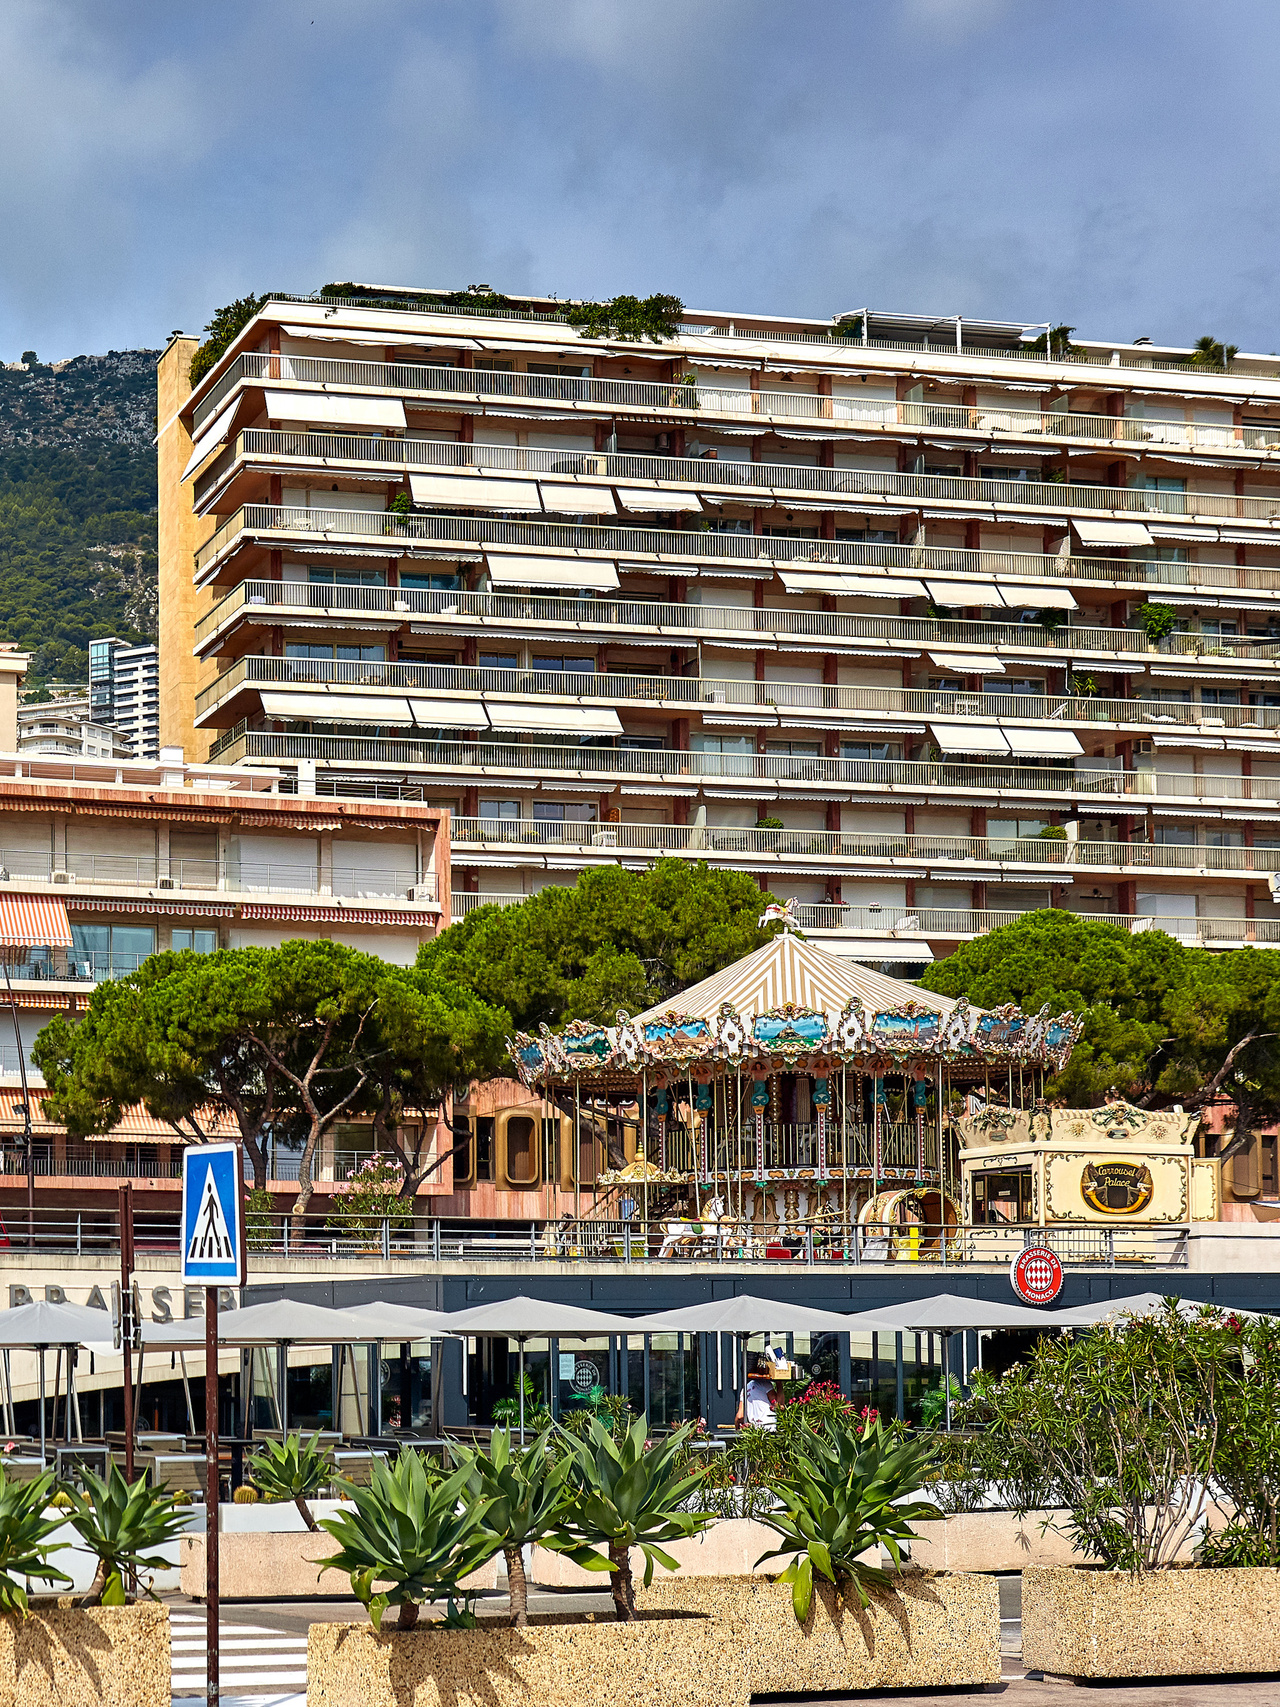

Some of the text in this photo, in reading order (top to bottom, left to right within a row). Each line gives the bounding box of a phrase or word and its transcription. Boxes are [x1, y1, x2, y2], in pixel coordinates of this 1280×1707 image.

[1098, 1166, 1137, 1177] Carrousel
[1104, 1176, 1131, 1187] Palace
[1019, 1249, 1059, 1270] BRASSERIE DE
[1025, 1289, 1055, 1300] MONACO
